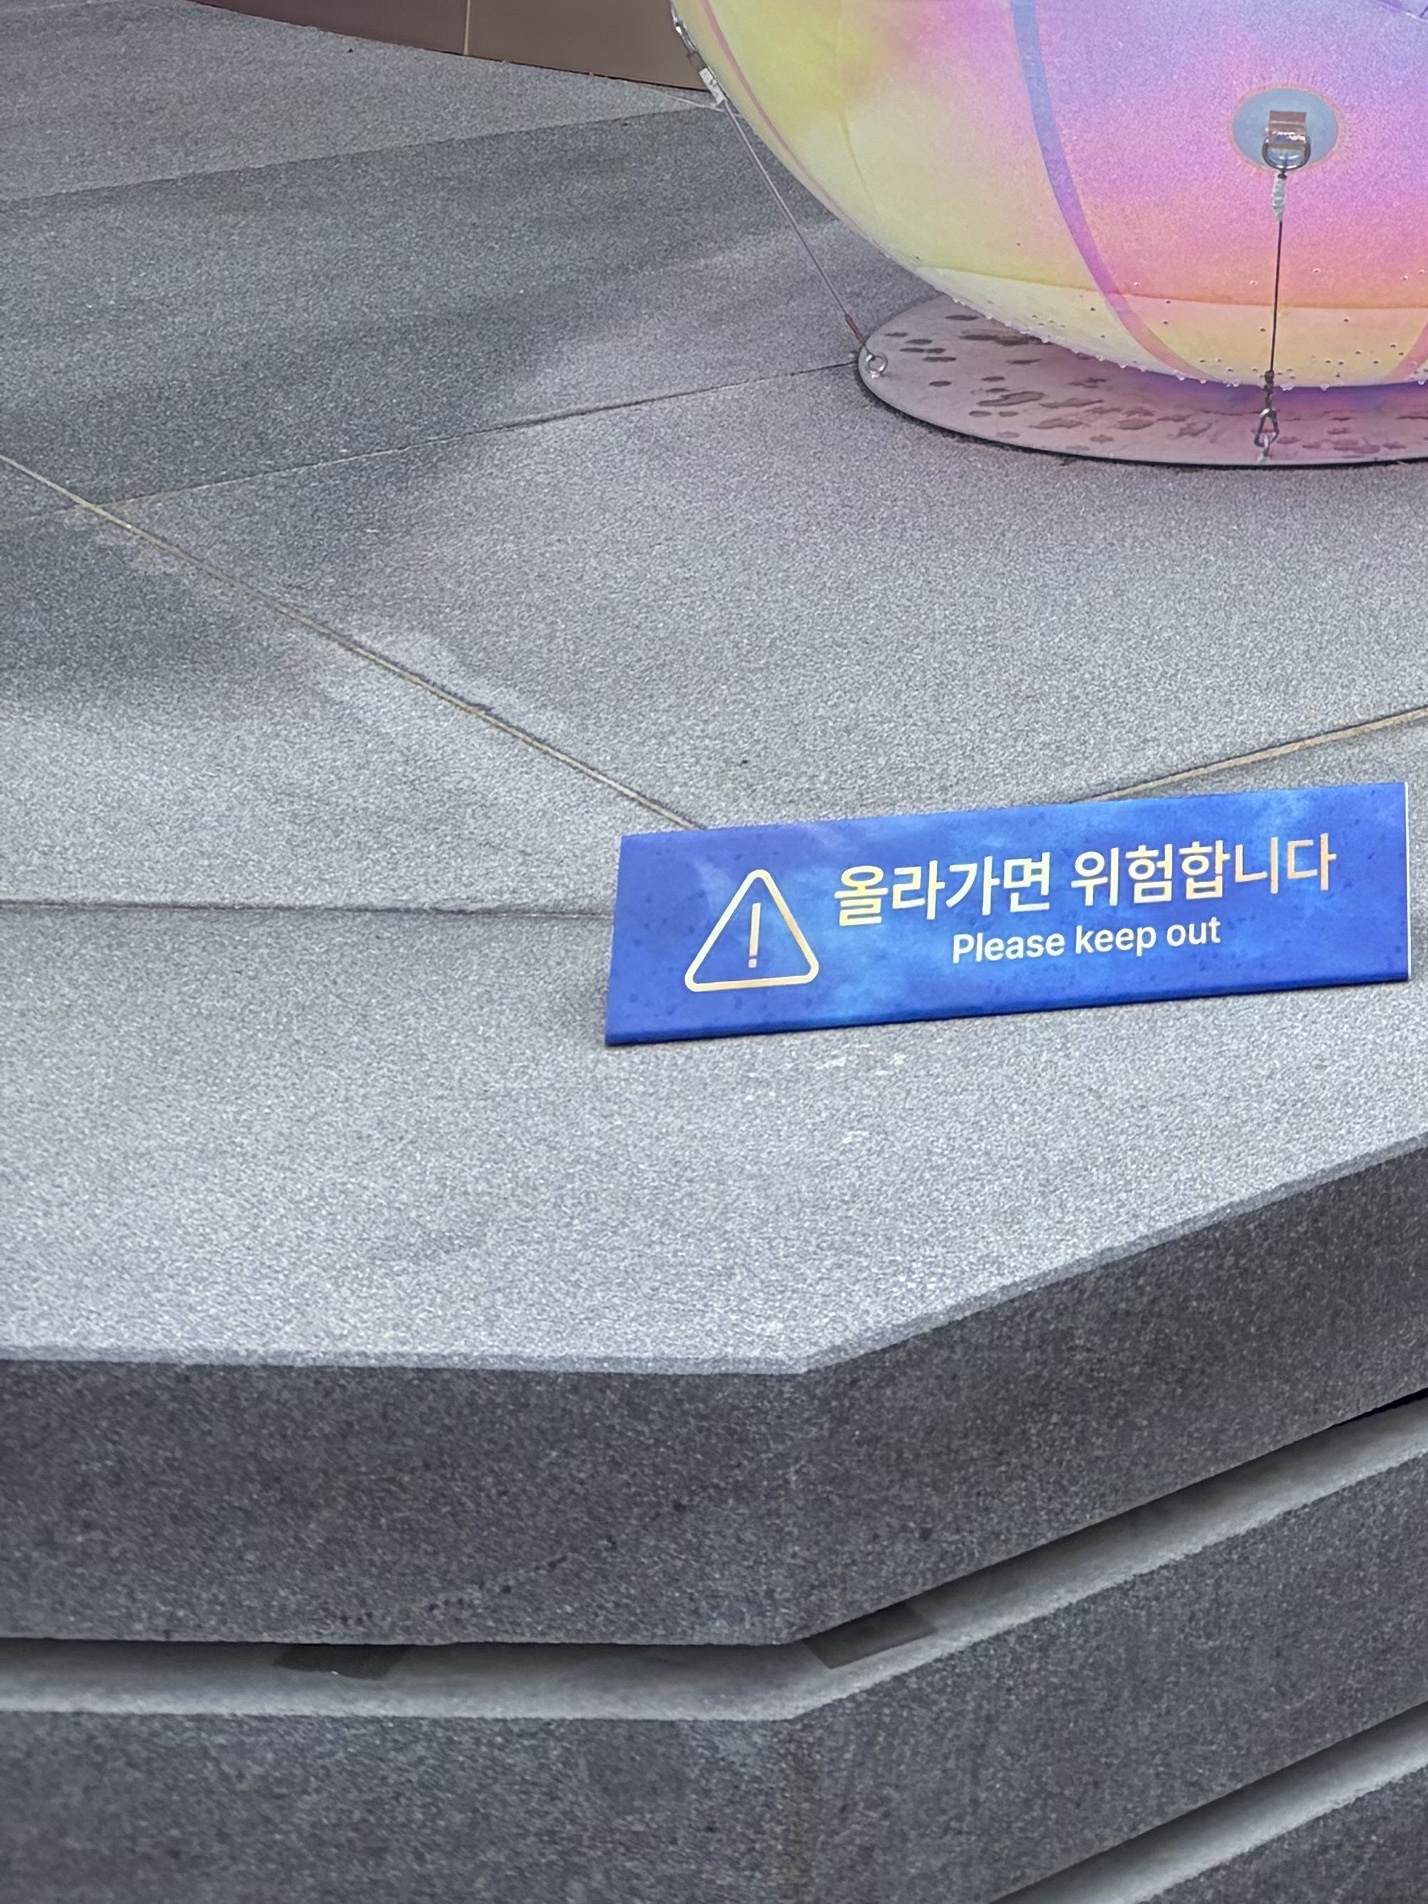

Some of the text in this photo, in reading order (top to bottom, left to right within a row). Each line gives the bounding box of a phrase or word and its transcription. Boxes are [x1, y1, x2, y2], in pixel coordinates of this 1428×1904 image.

[834, 833, 1337, 926] 올라가면 위험합니다
[953, 916, 1221, 964] Please keep out
